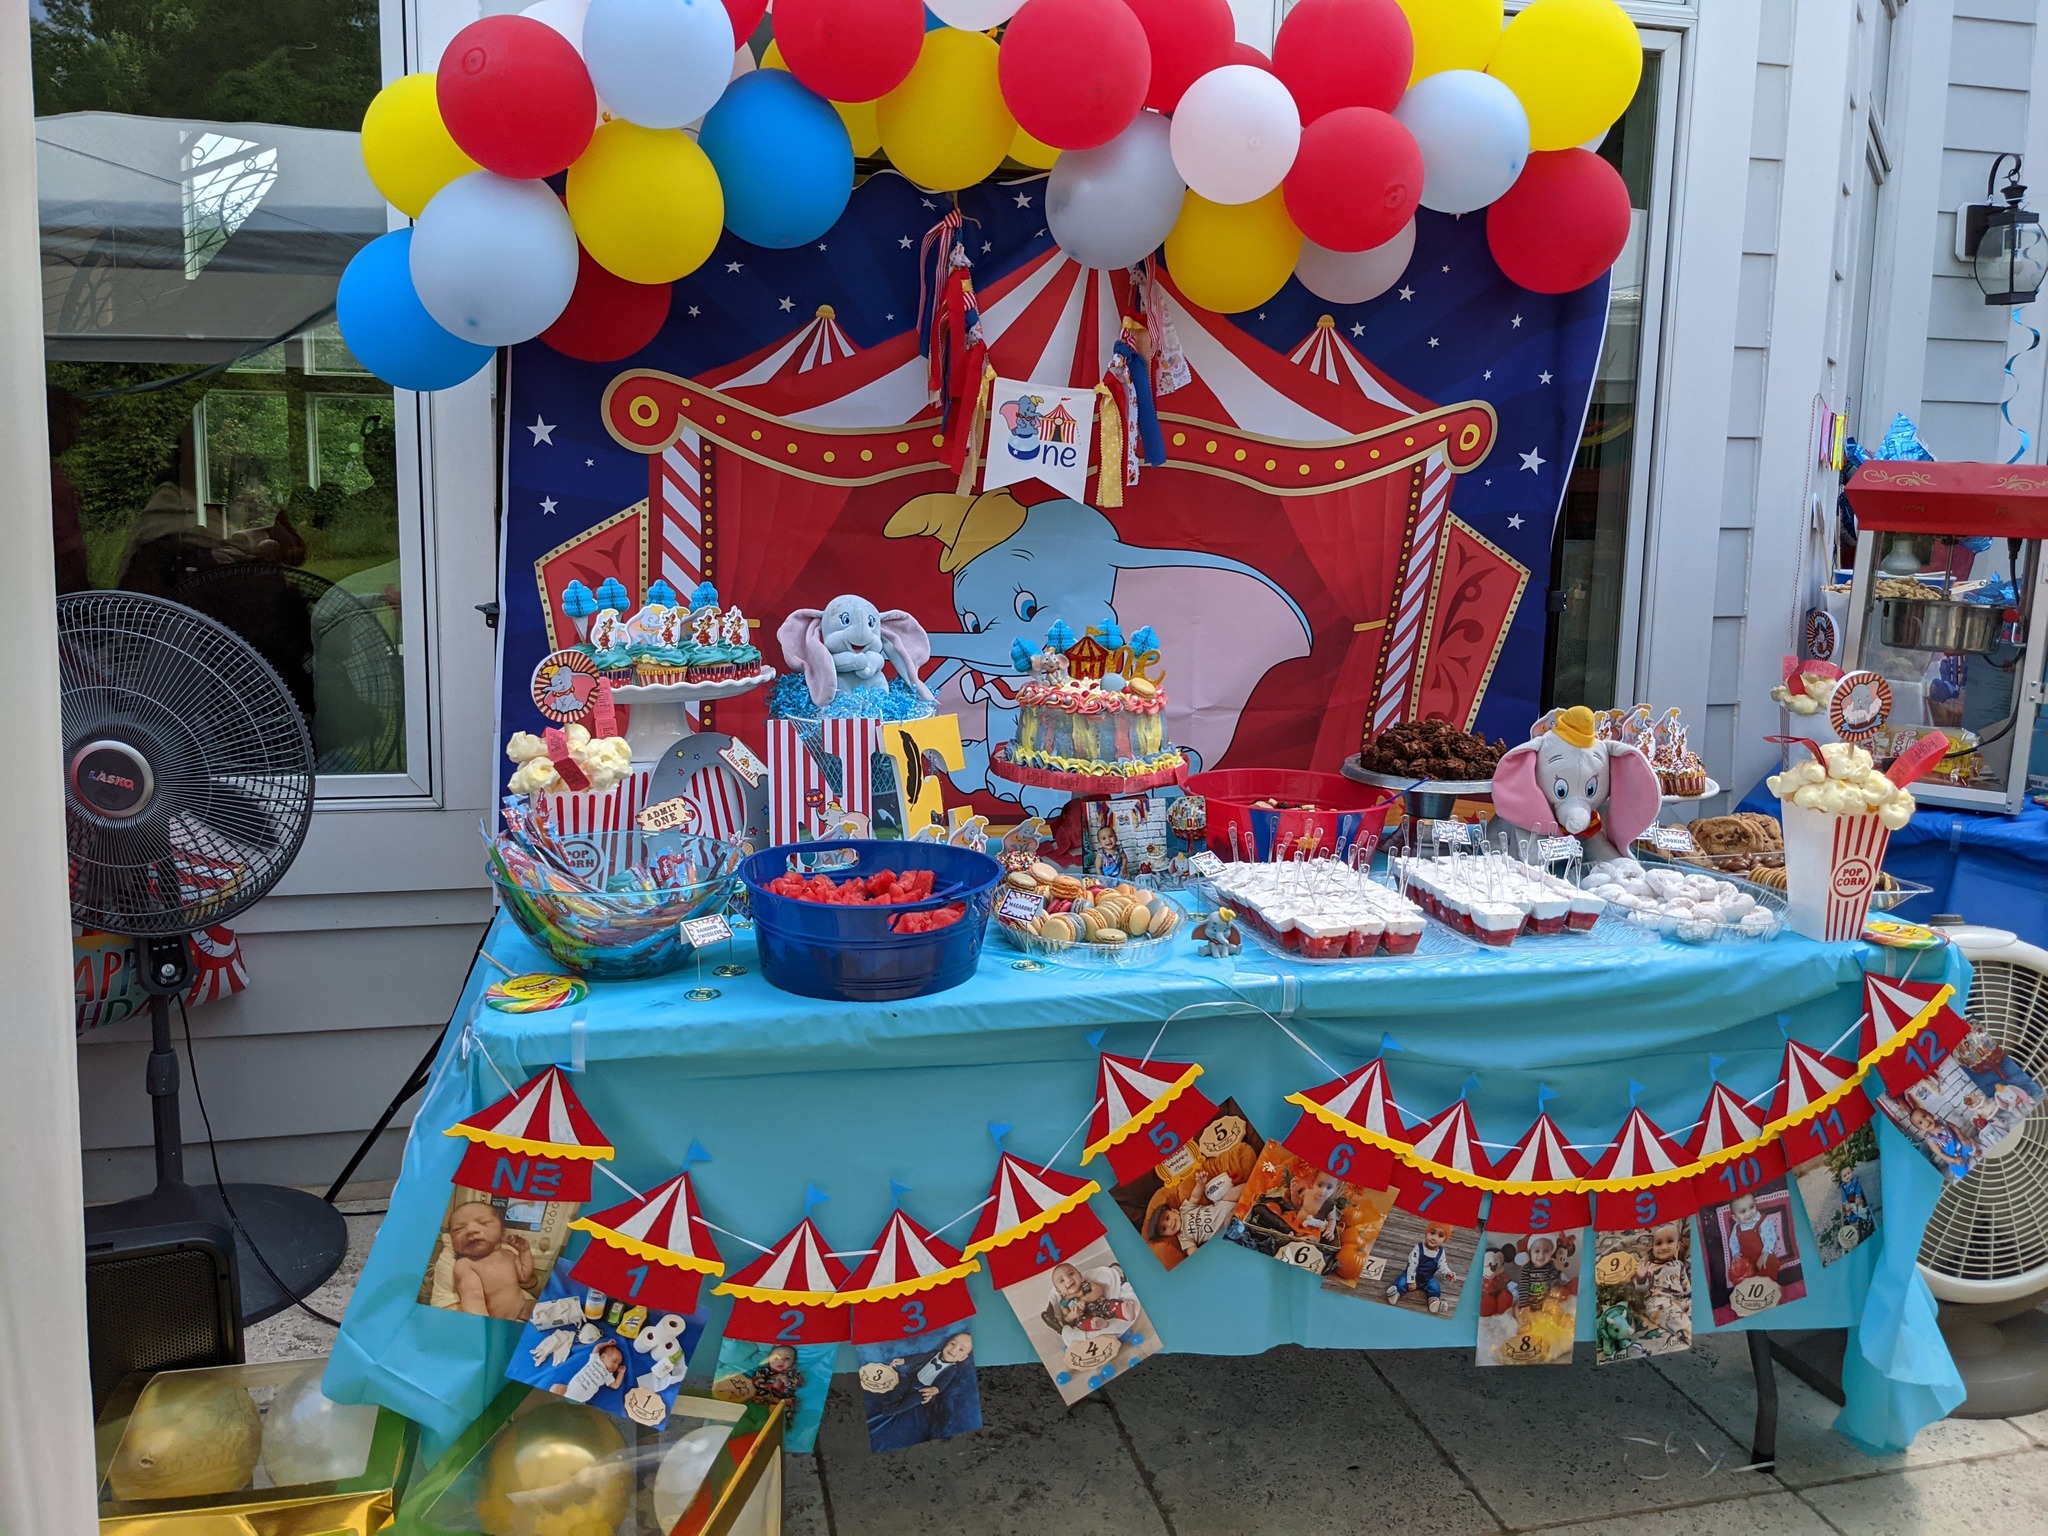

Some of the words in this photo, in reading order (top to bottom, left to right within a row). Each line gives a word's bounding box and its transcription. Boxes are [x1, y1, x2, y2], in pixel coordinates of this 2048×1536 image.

[88, 769, 134, 789] LASKO
[647, 803, 677, 821] ADMIT
[654, 812, 678, 828] ONE
[1836, 876, 1867, 887] CORN
[1842, 868, 1863, 877] POP
[1009, 901, 1034, 912] MACARONS
[75, 948, 136, 1003] APP
[1905, 1030, 1948, 1072] 12
[1214, 1122, 1228, 1141] 5
[1810, 1108, 1846, 1147] 11
[1148, 1121, 1179, 1154] 5
[1328, 1143, 1355, 1177] 6
[1719, 1158, 1761, 1193] 10
[1418, 1181, 1445, 1212] 7
[1635, 1192, 1657, 1224] 9
[1294, 1246, 1310, 1264] 6
[1366, 1259, 1375, 1270] 7
[1610, 1258, 1620, 1272] 9
[627, 1265, 649, 1298] 1
[1748, 1284, 1764, 1298] 10
[776, 1310, 804, 1340] 2
[901, 1301, 927, 1333] 3
[1086, 1341, 1098, 1356] 4
[1520, 1336, 1531, 1351] 8
[872, 1369, 883, 1381] 3
[643, 1395, 651, 1408] 1
